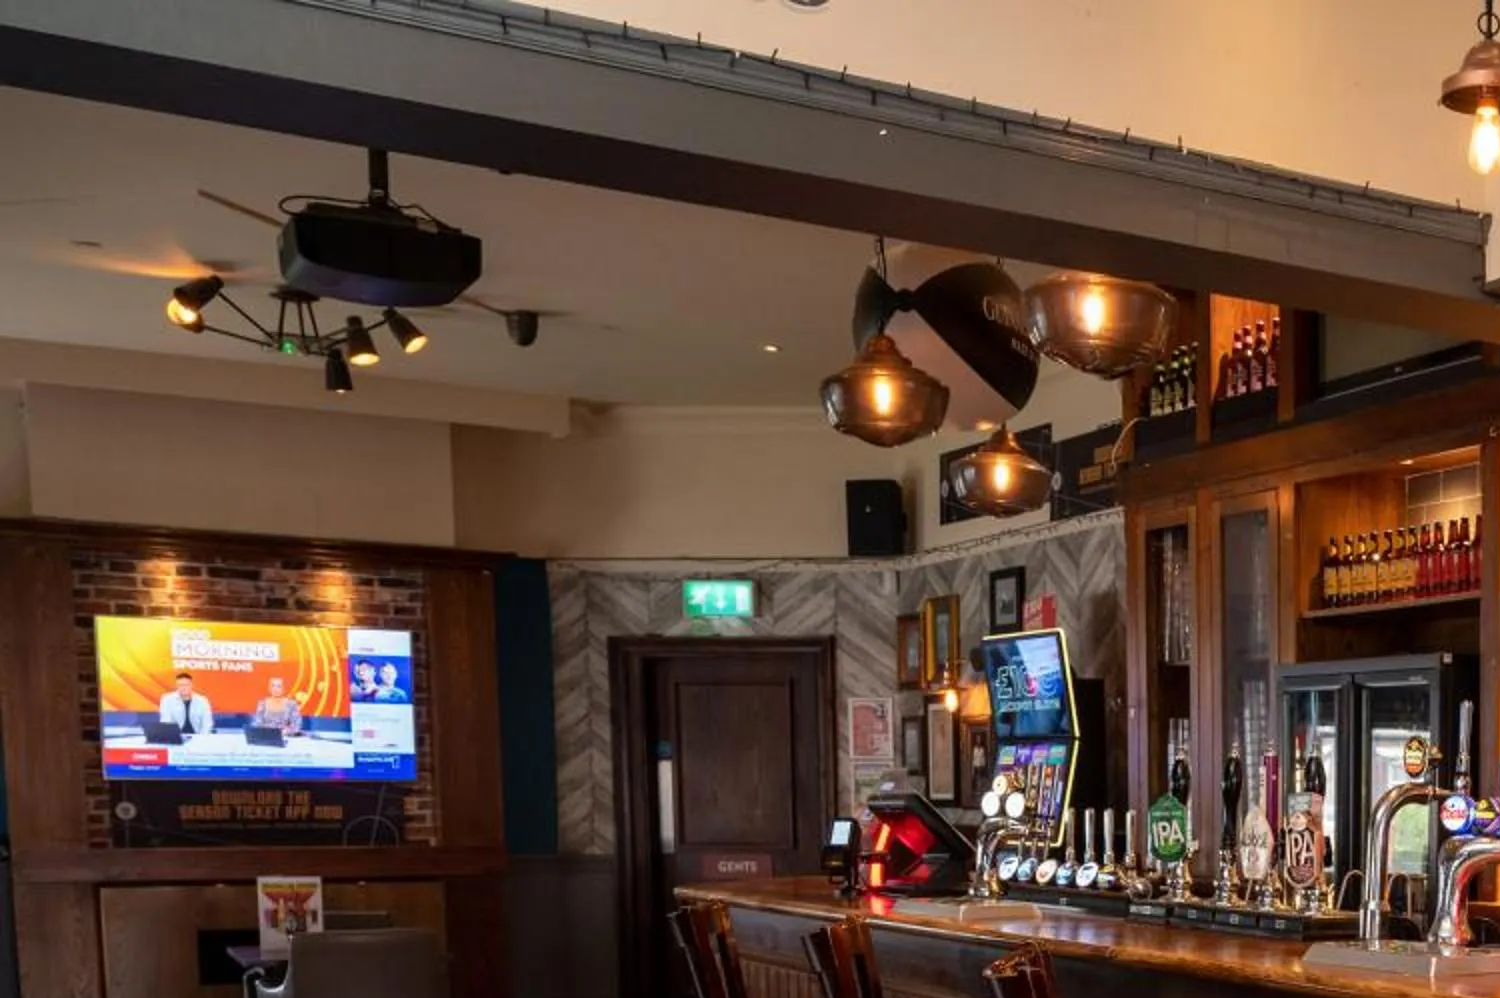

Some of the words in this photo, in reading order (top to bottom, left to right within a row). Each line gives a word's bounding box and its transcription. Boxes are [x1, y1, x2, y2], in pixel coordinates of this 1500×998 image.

[1151, 819, 1185, 848] IPA
[1287, 830, 1316, 867] IPA
[717, 861, 758, 873] GENTS
